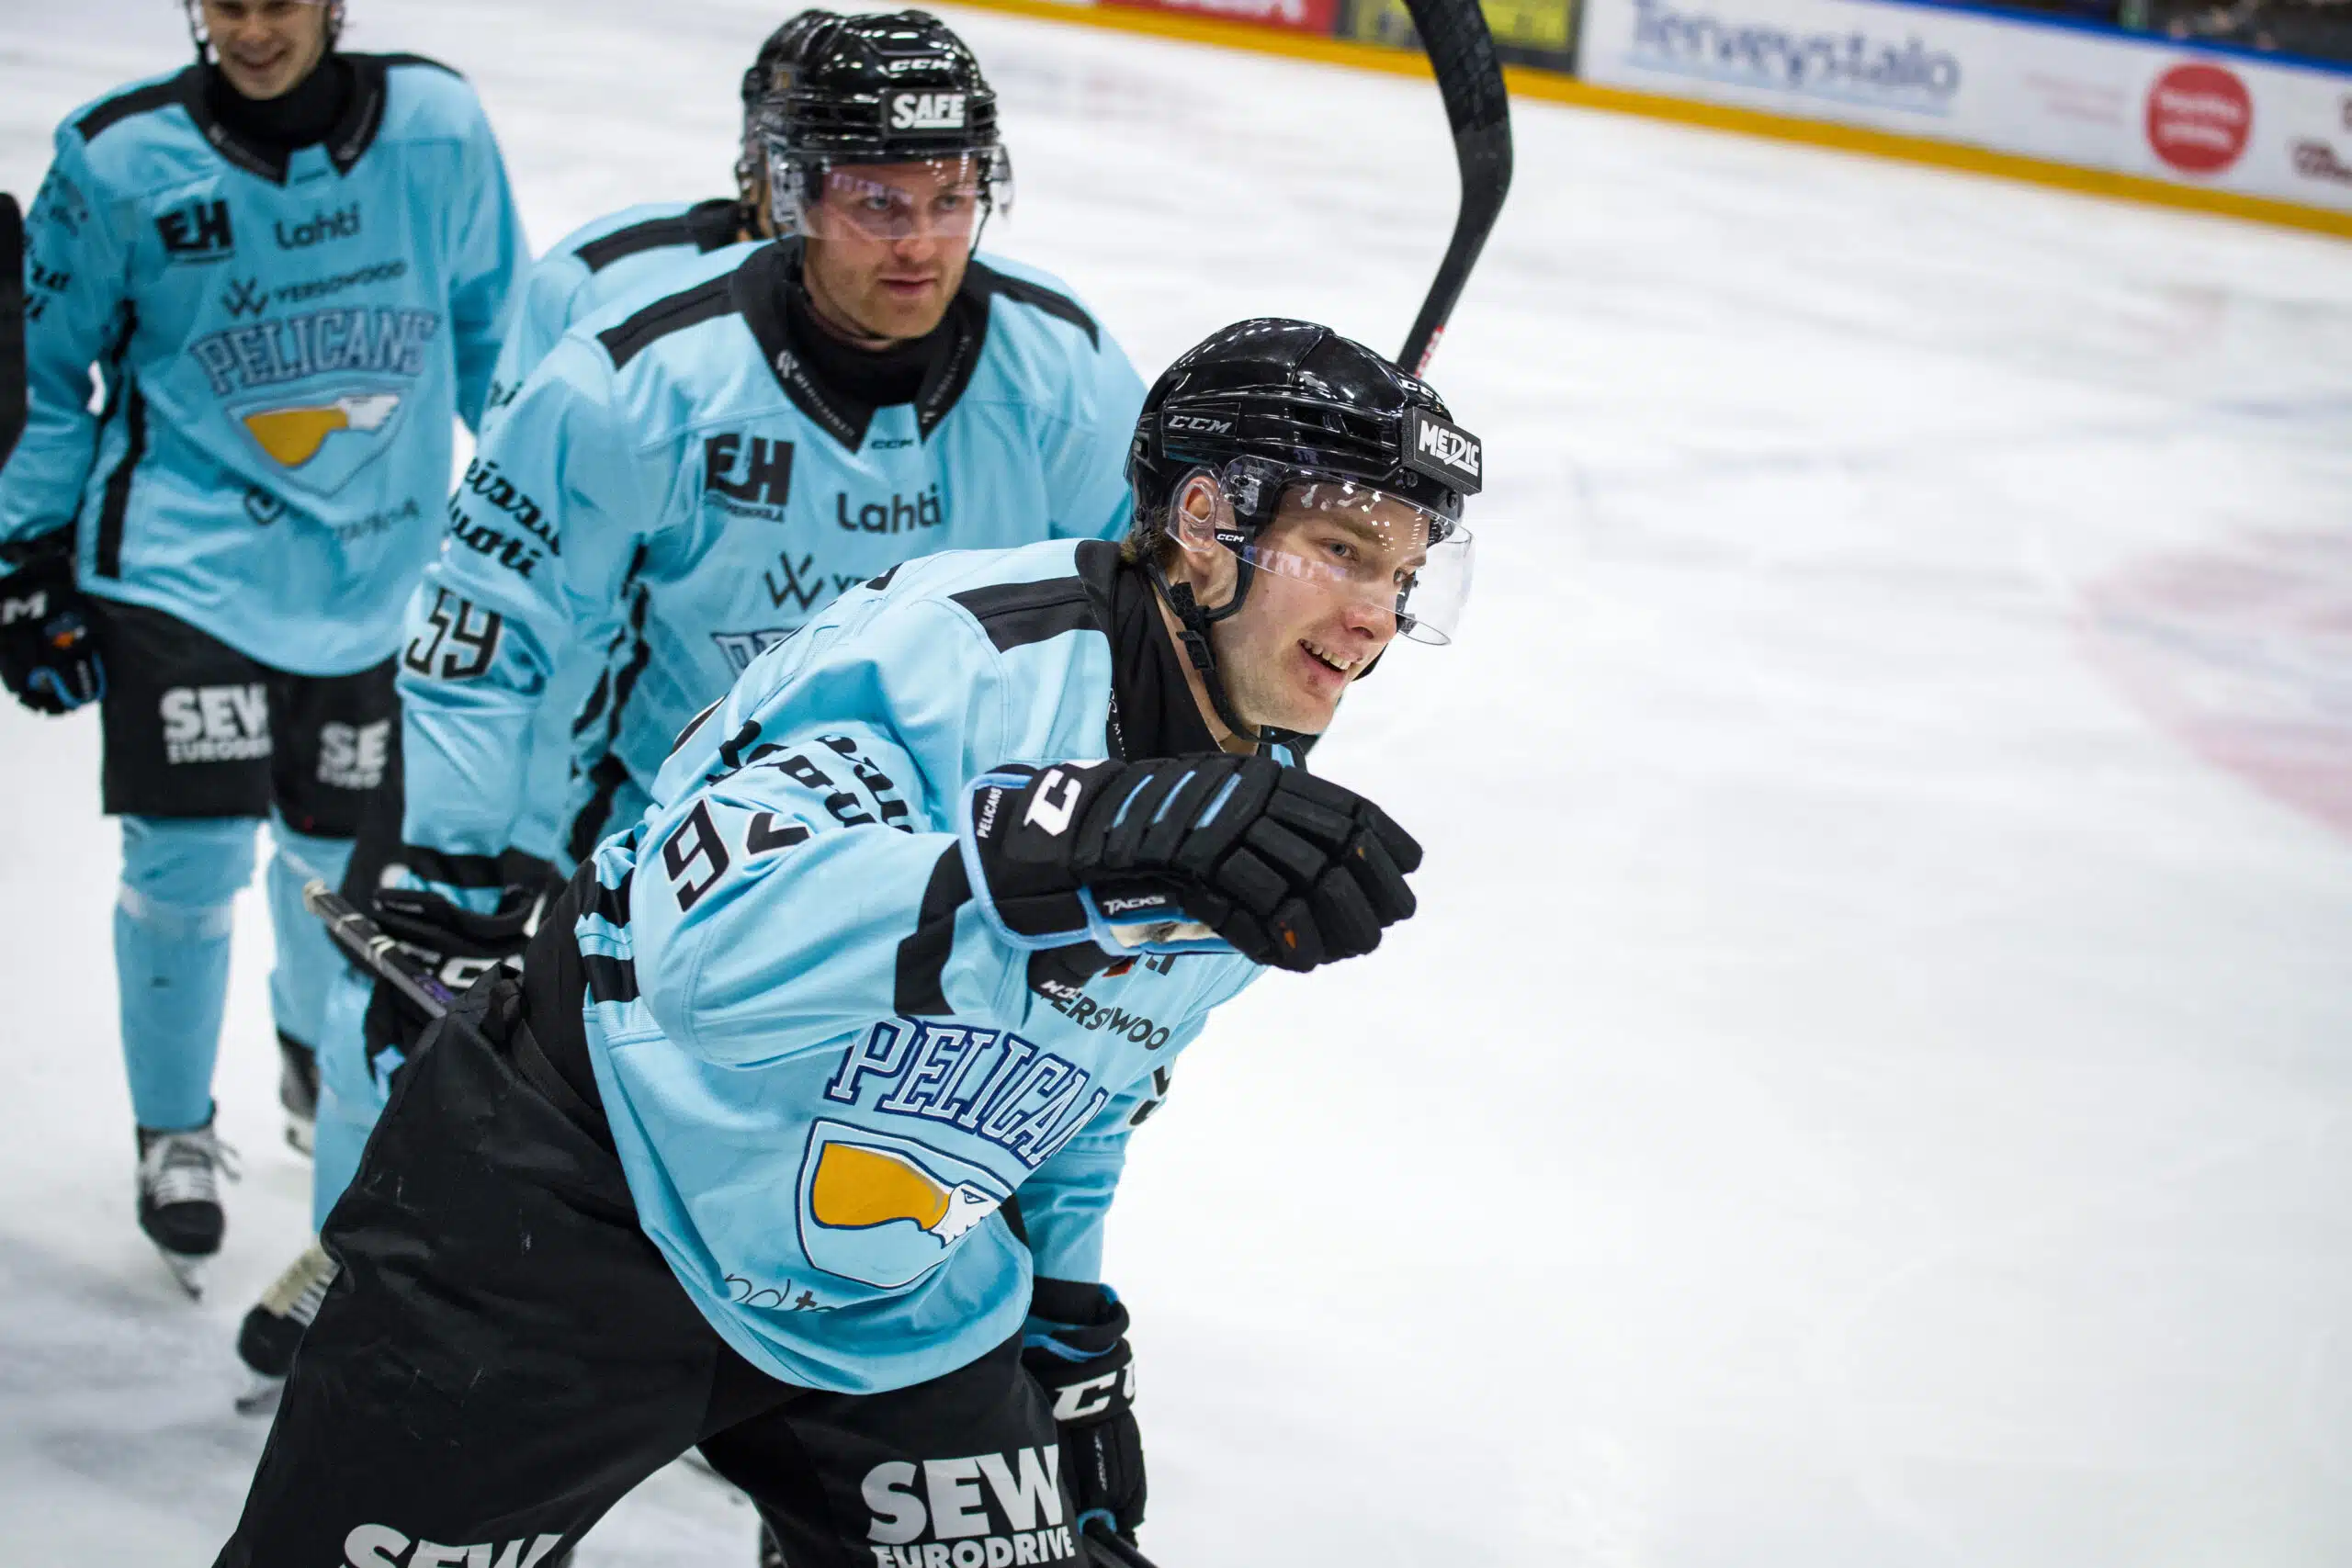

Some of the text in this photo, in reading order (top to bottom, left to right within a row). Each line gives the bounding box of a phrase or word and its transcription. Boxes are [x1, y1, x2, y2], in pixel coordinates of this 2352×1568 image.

[891, 93, 966, 129] SAFE
[276, 200, 361, 251] Lahti
[1168, 414, 1232, 434] CCM
[1418, 419, 1480, 477] MEDIC
[837, 484, 942, 535] Lahti
[1216, 532, 1245, 543] CCM
[404, 586, 503, 681] 59
[319, 719, 390, 772] SE
[976, 786, 1003, 839] PELICANS
[1103, 895, 1167, 916] TACKS
[824, 1015, 1110, 1169] PELICAN
[861, 1443, 1063, 1545] SEW
[870, 1526, 1076, 1568] EURODRIVE
